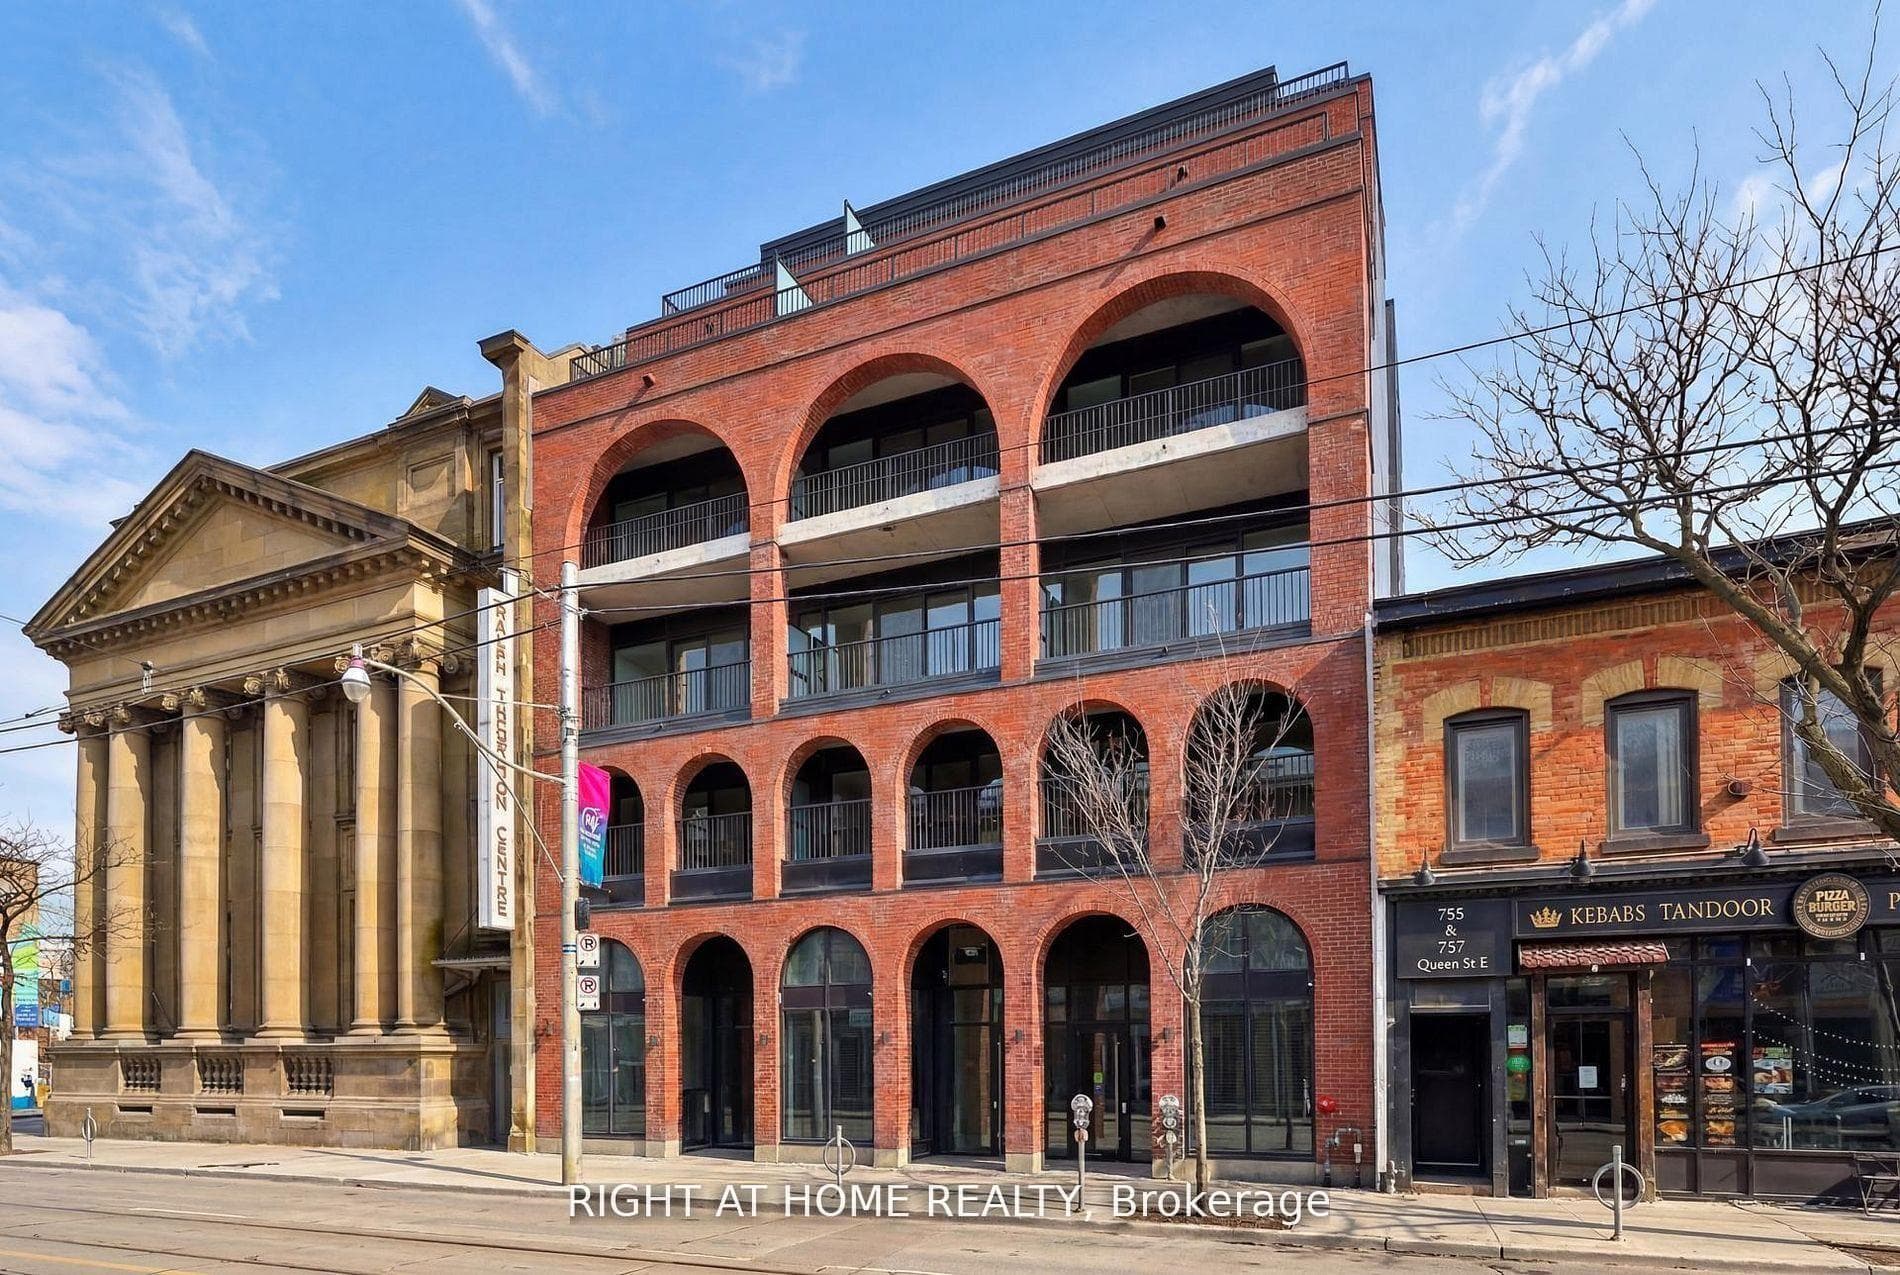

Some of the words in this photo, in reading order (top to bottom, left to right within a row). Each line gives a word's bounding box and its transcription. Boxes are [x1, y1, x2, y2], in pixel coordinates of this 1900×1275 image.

[496, 687, 507, 812] THORON
[497, 826, 507, 917] CENTRE
[1816, 889, 1849, 901] PIZZA
[1571, 904, 1646, 925] KEBABS
[1659, 898, 1774, 920] TANDOOR
[1808, 900, 1856, 913] BURGER
[1438, 907, 1465, 921] 755
[1445, 924, 1457, 937] &
[1438, 940, 1466, 954] 757
[1417, 958, 1459, 973] Queen
[1463, 957, 1476, 969] St
[1480, 956, 1489, 969] E
